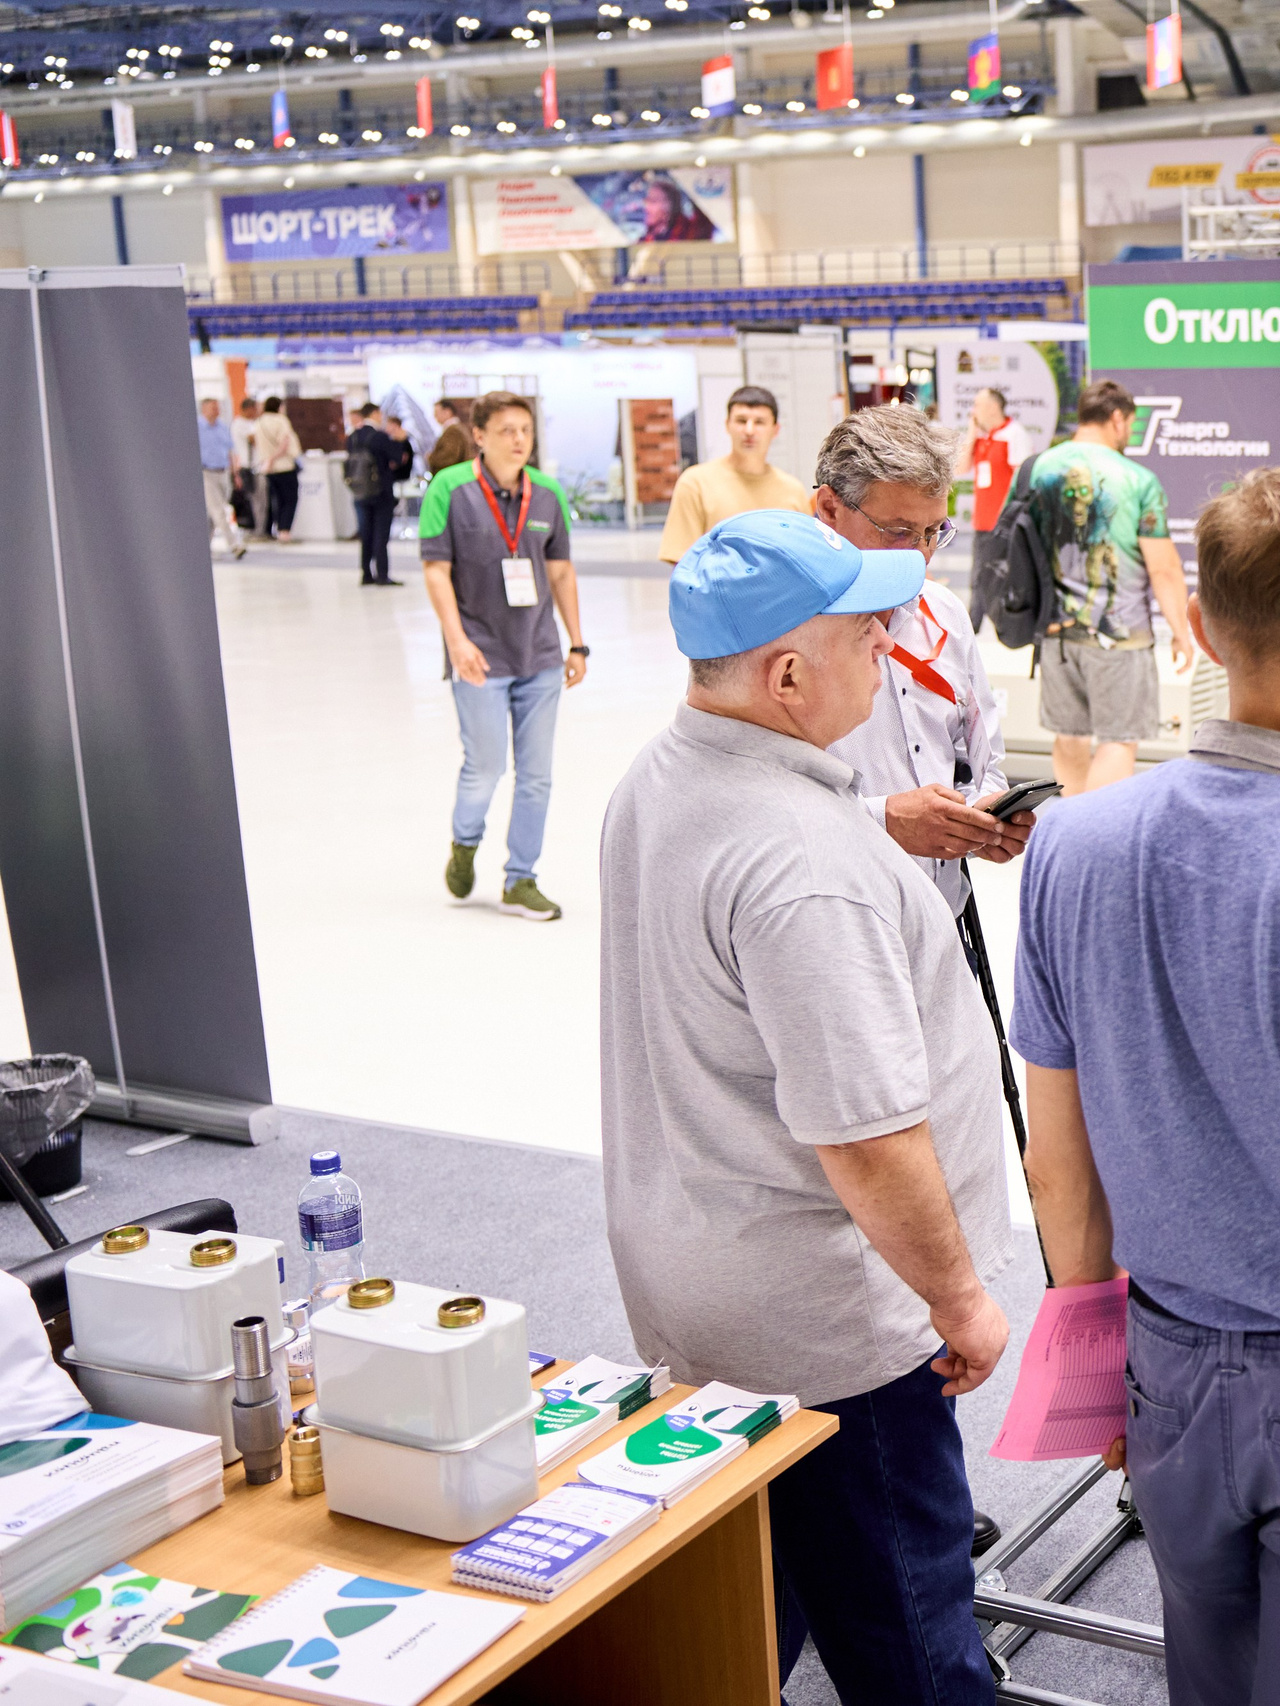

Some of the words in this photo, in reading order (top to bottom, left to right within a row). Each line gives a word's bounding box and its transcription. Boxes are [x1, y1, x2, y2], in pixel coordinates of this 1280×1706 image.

[231, 205, 396, 245] ШОРТ-ТРЕК
[1160, 419, 1230, 441] Энерго
[1155, 437, 1271, 457] Технологии
